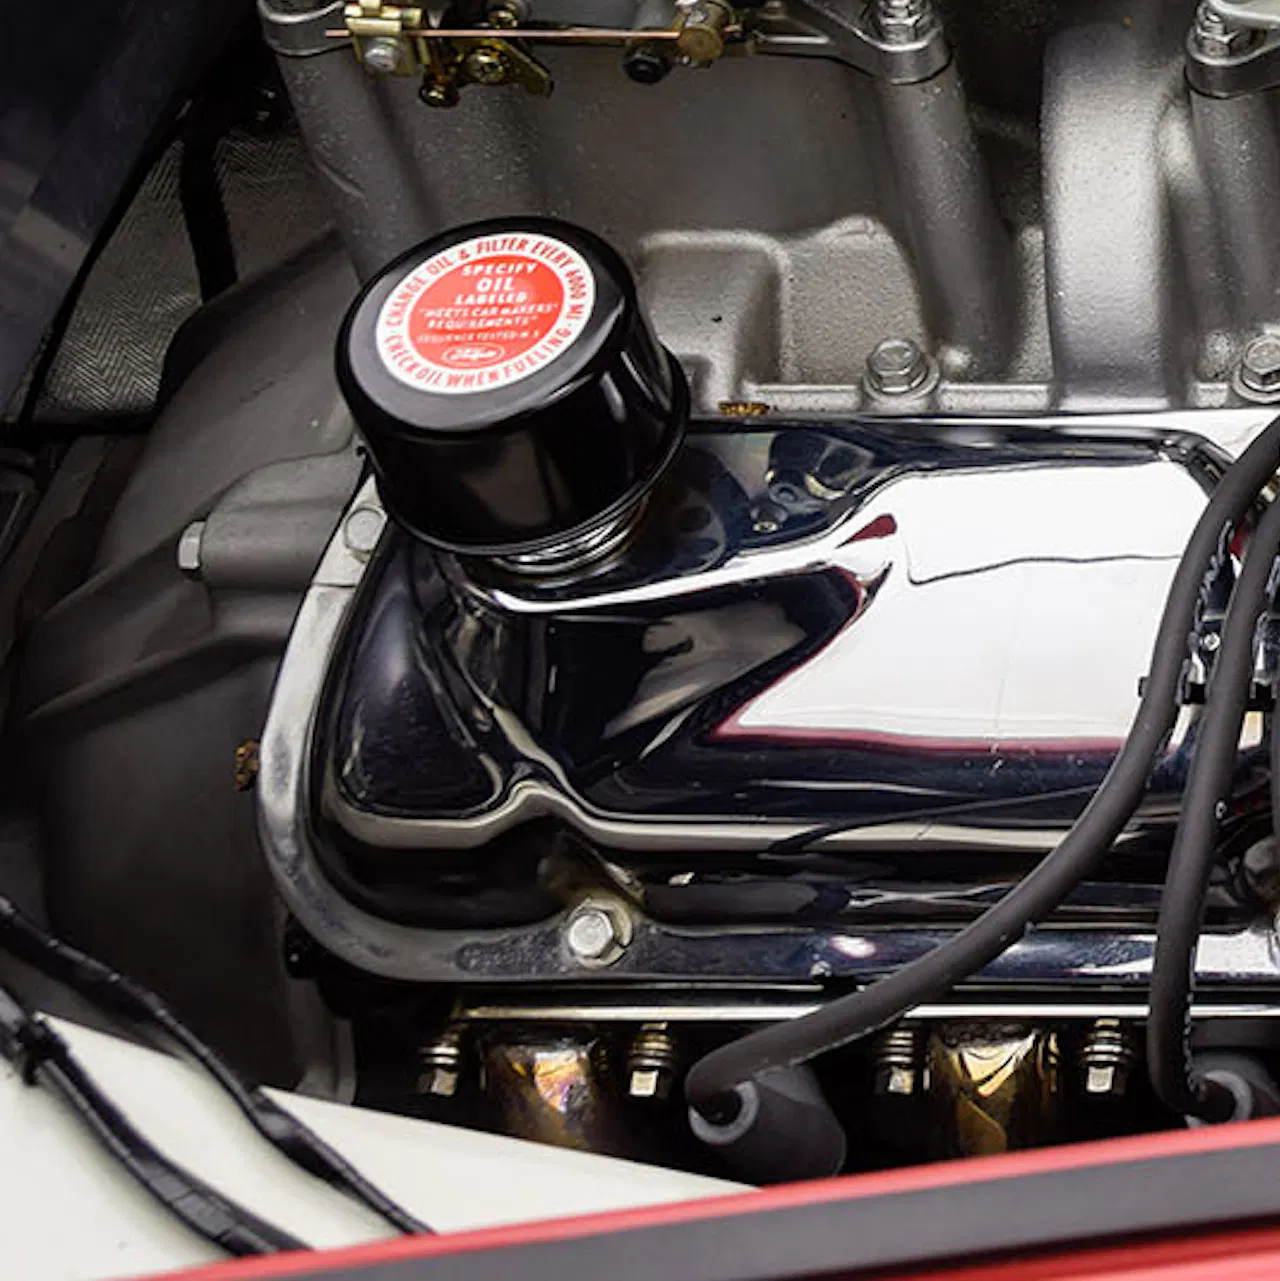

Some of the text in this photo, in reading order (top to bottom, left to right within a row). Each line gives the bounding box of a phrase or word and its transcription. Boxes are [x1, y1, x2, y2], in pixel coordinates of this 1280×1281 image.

[427, 256, 454, 275] OIL
[476, 237, 530, 255] FILTER
[531, 240, 575, 269] EVERY
[460, 261, 539, 277] SPECIFY
[475, 277, 516, 294] OIL
[454, 291, 529, 306] LABELED
[471, 305, 499, 317] CAR
[384, 333, 418, 374] CHECK
[416, 366, 442, 386] OIL
[446, 372, 501, 387] WHEN
[503, 327, 572, 378] FUELING
